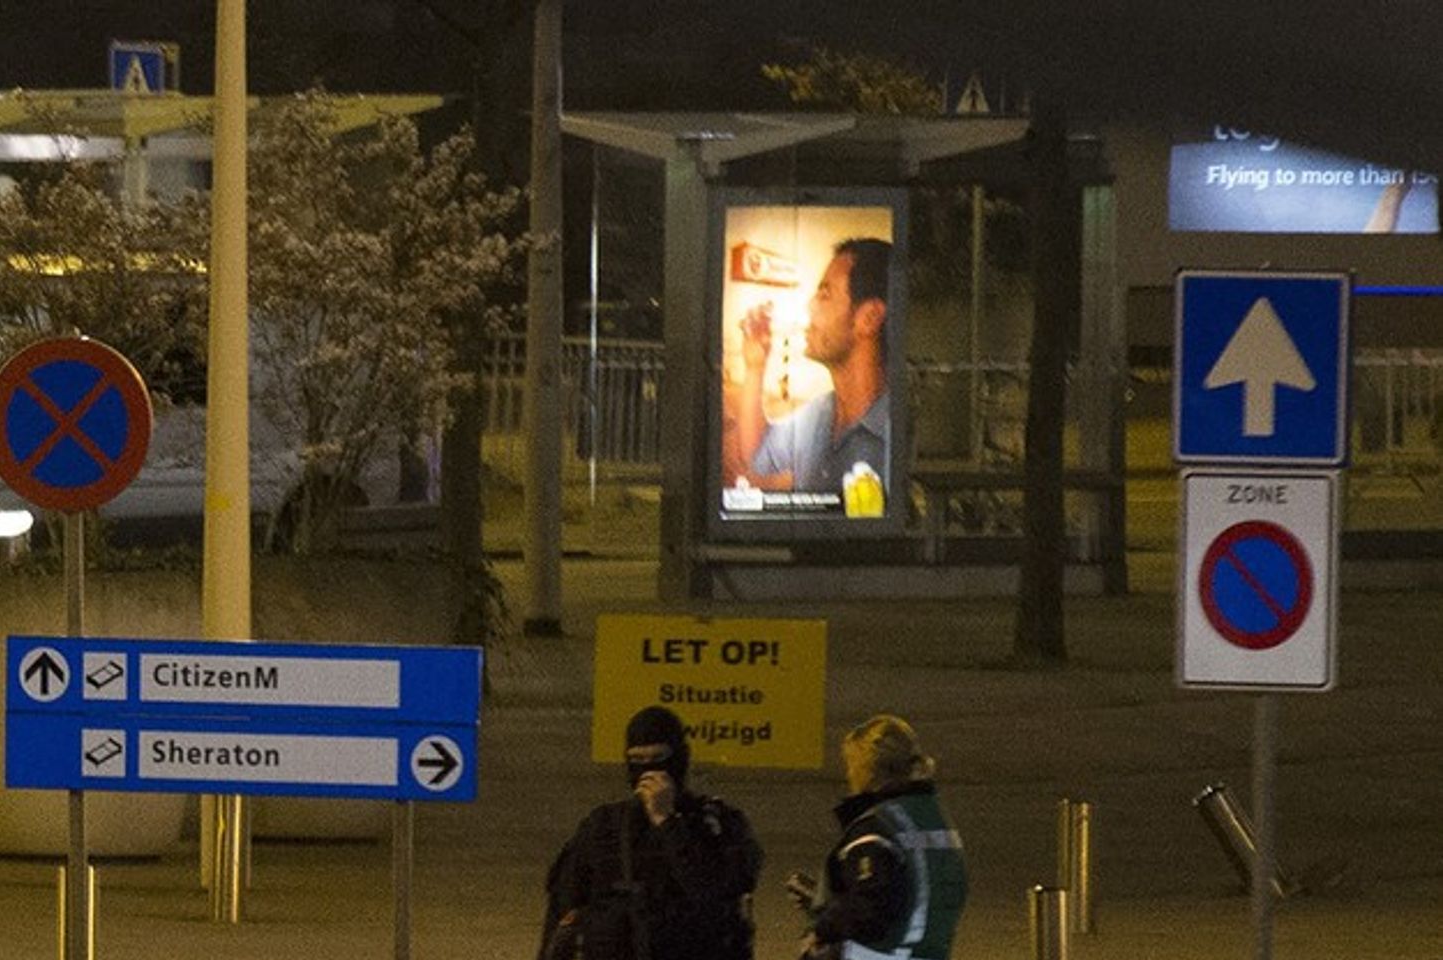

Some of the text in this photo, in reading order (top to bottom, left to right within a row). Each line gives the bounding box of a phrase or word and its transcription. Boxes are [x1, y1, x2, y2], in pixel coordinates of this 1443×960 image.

[1206, 164, 1269, 191] Flying
[1275, 167, 1296, 185] to
[1301, 169, 1355, 186] more
[1359, 163, 1405, 186] than
[1226, 484, 1289, 504] ZONE
[642, 638, 780, 667] LET OP!
[152, 662, 280, 690] CitizenM
[659, 683, 764, 705] Situatie
[682, 720, 772, 746] wijzigd
[151, 739, 281, 767] Sheraton
